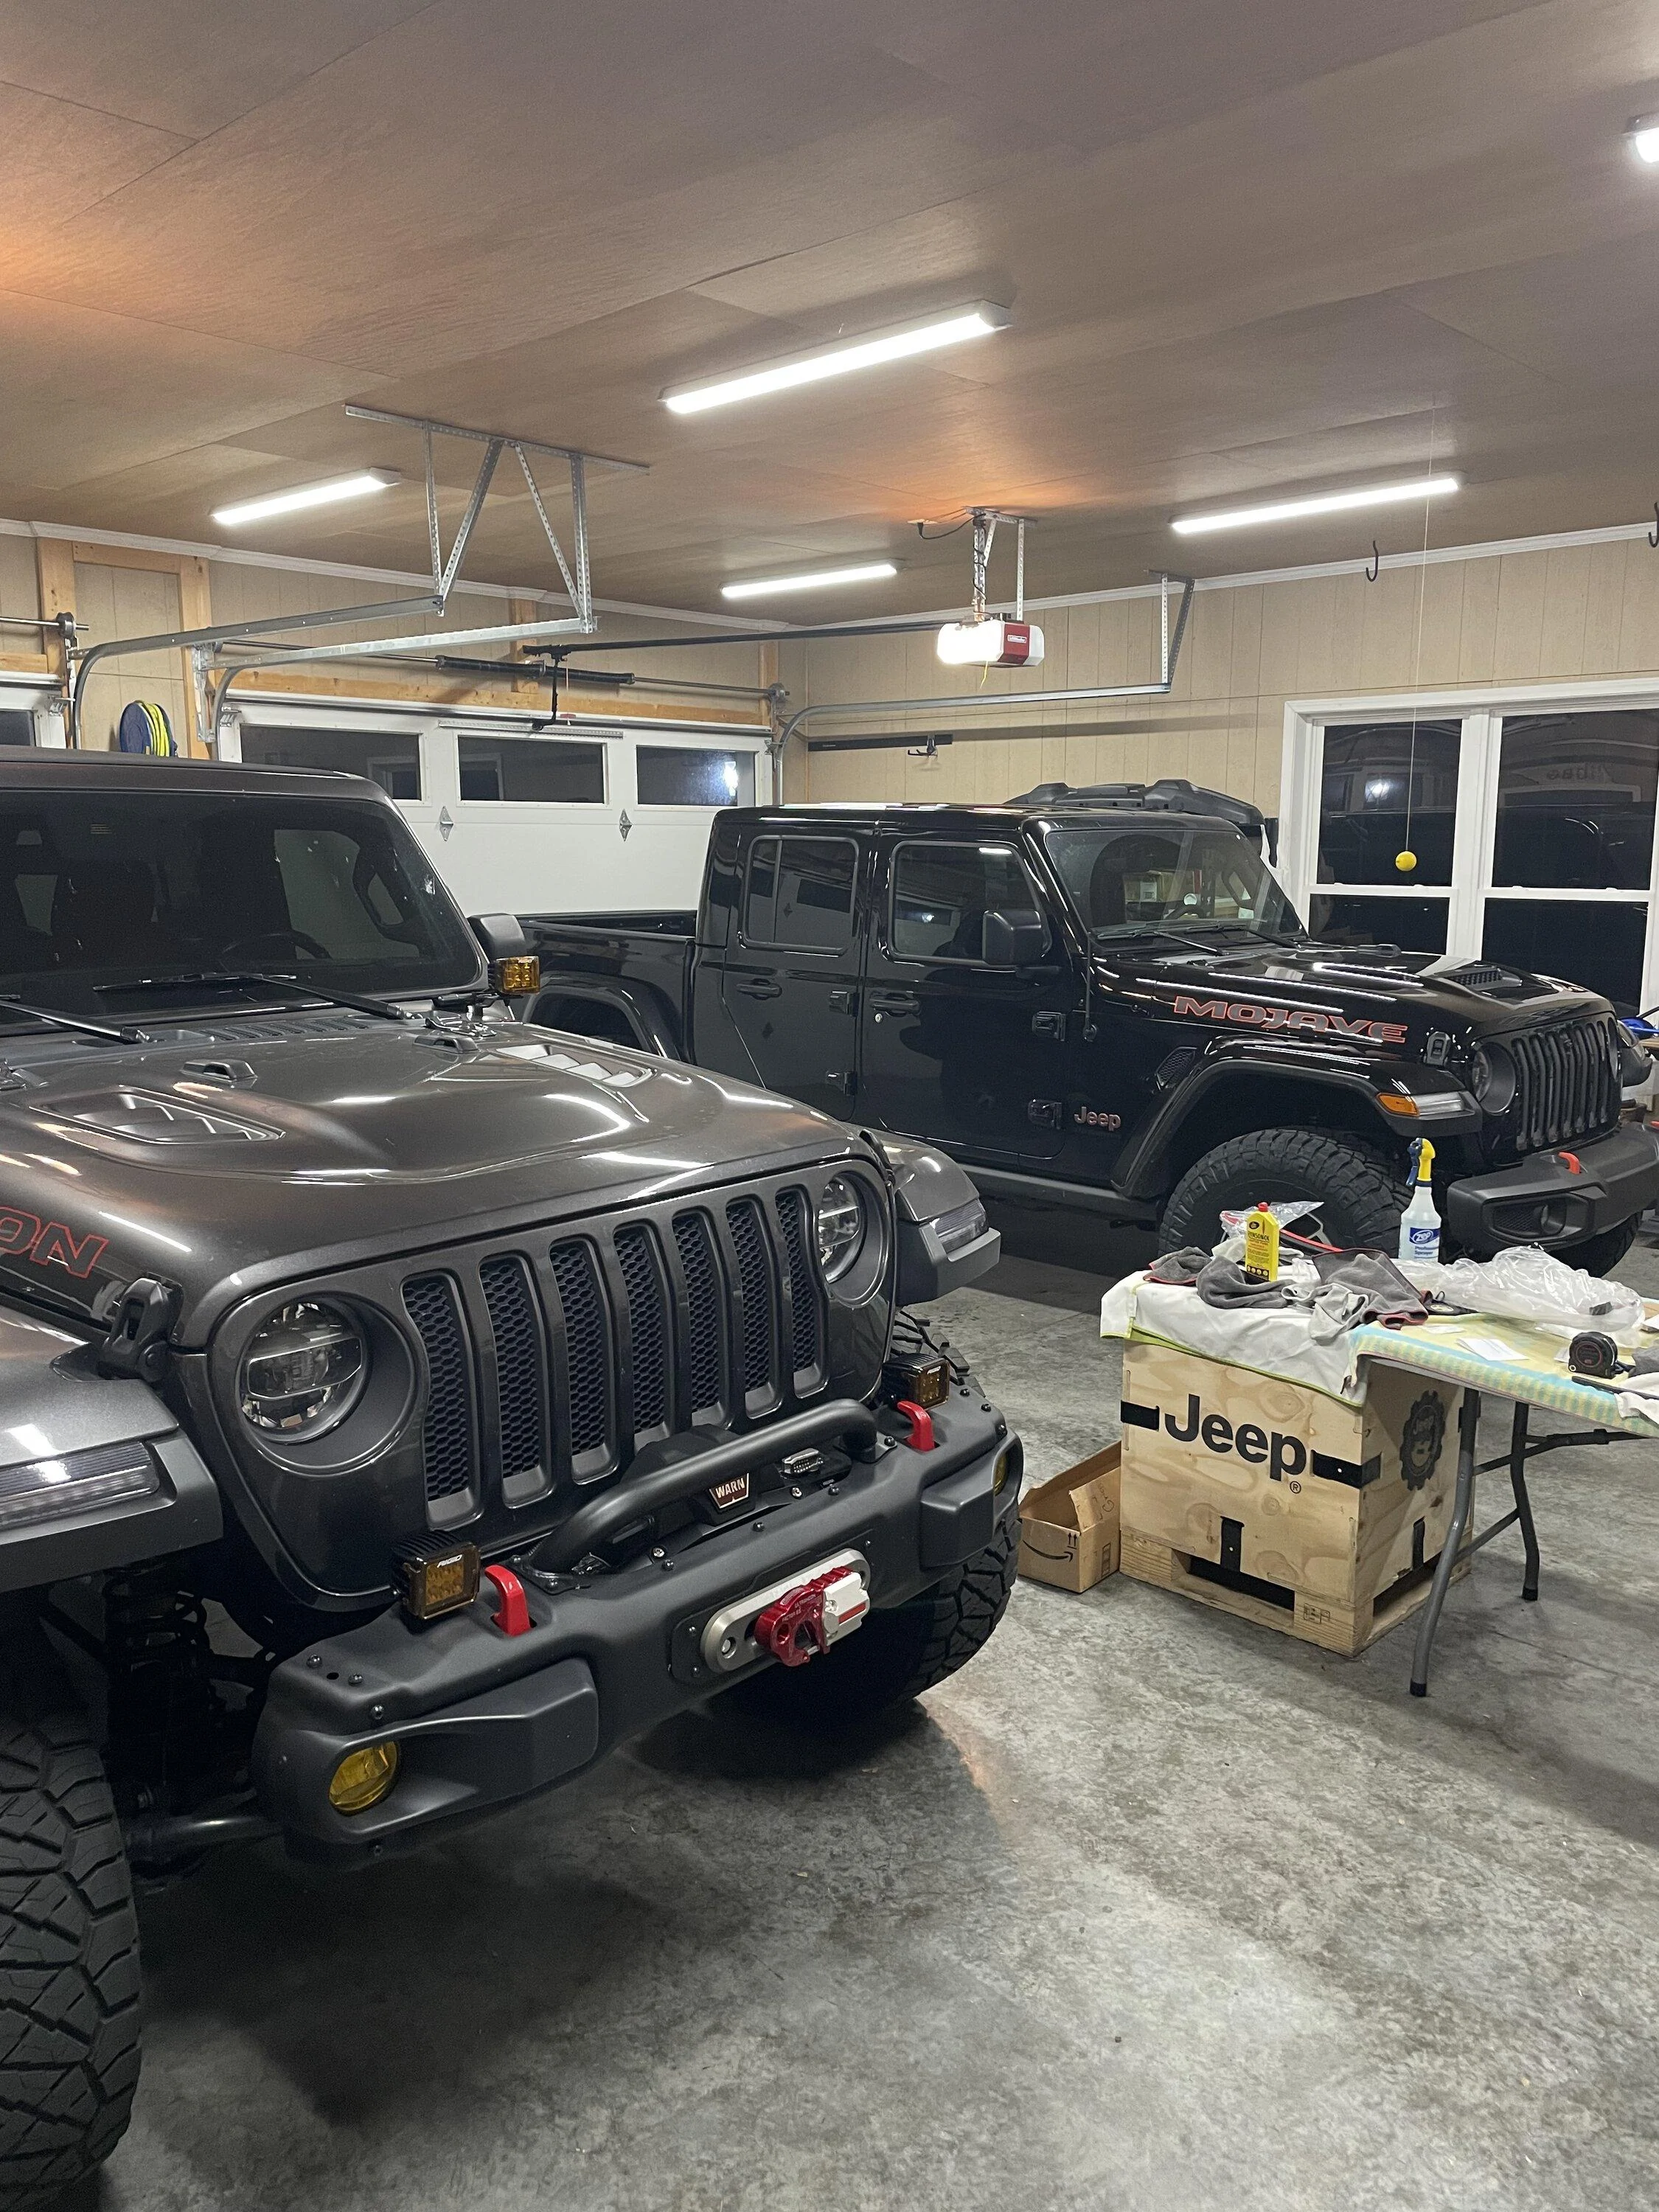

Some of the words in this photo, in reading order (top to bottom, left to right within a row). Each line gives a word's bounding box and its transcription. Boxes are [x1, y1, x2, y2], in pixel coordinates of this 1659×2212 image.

[1174, 995, 1408, 1043] MOJAVE
[1074, 1106, 1121, 1132] Jeep
[1164, 1393, 1307, 1482] Jeep
[714, 1478, 745, 1499] WARN
